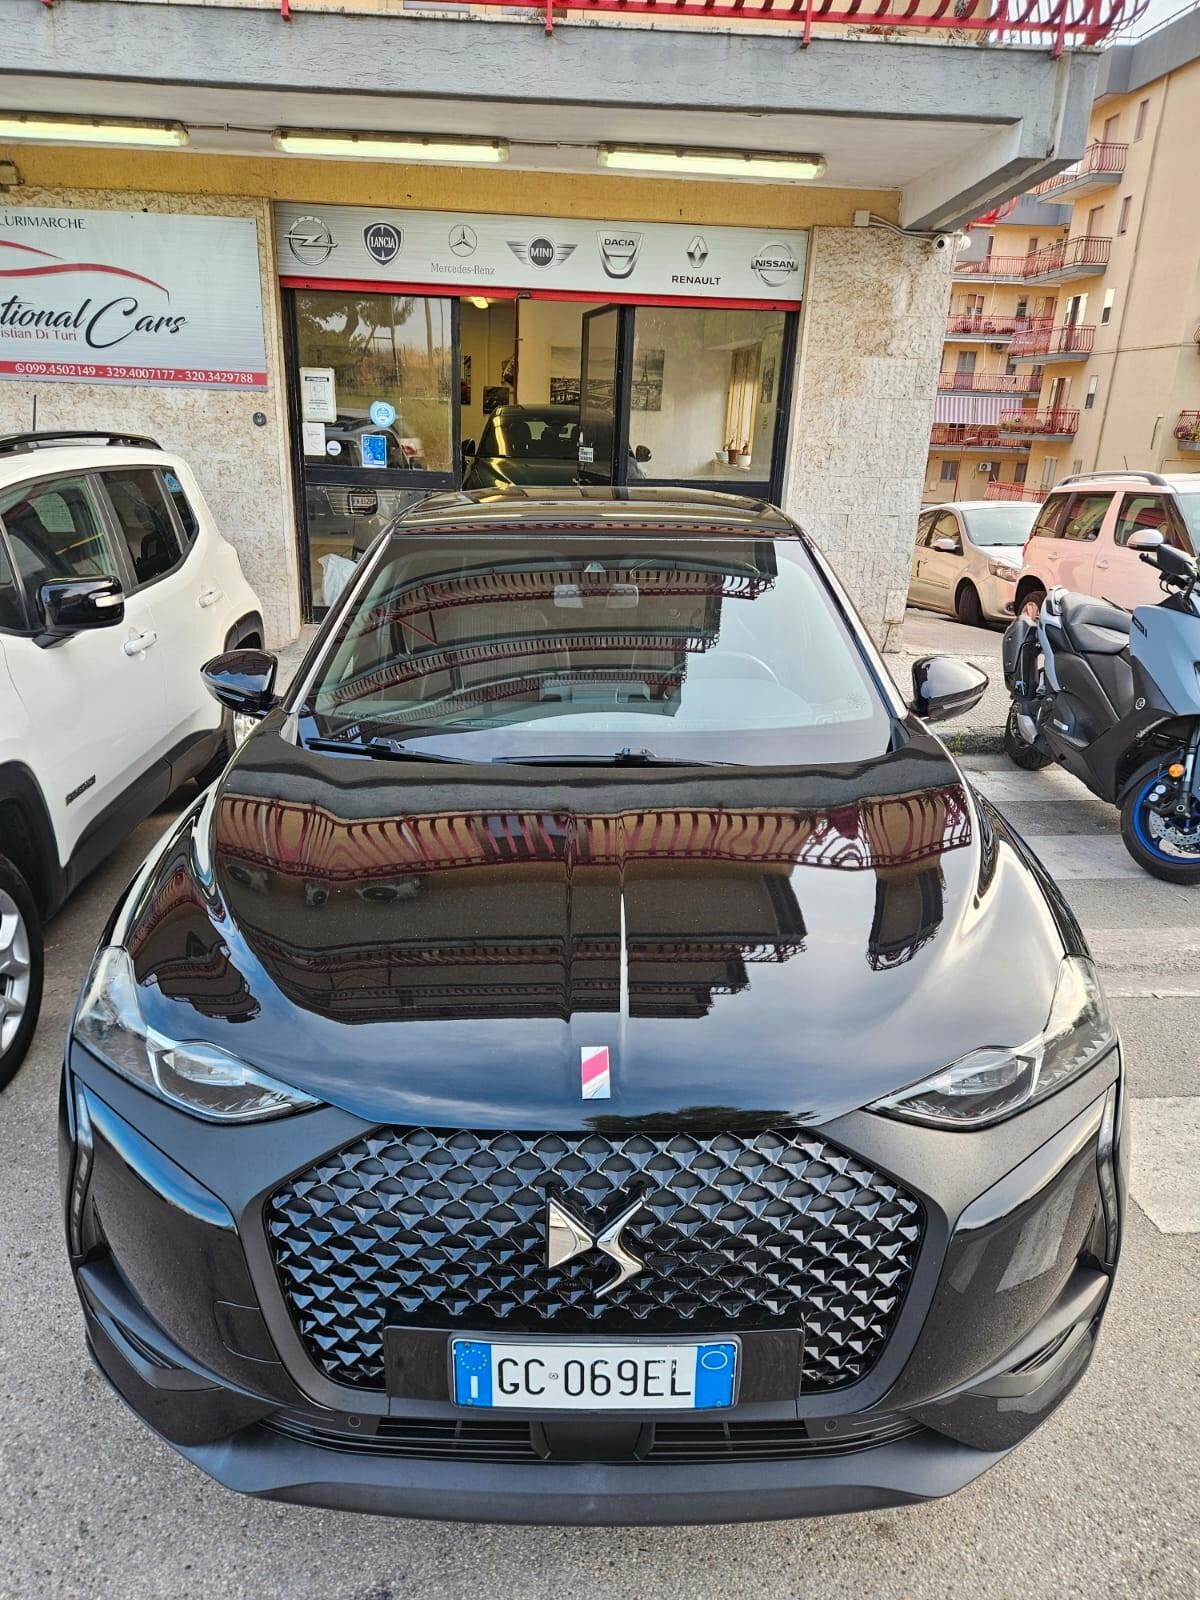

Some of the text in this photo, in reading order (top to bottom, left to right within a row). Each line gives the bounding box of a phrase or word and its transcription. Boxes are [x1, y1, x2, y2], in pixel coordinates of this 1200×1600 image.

[370, 236, 396, 249] LANCIA
[604, 237, 635, 247] DACIA
[530, 247, 553, 258] MINI
[430, 263, 496, 275] Mercedes-Benz
[755, 259, 794, 269] NISSAN
[671, 275, 721, 286] RENAULT
[0, 295, 189, 349] tional Cars
[36, 328, 49, 340] Di
[52, 329, 77, 341] Turi
[25, 363, 96, 377] 099.4502149
[106, 367, 175, 380] 329.4007177
[185, 371, 253, 383] 320.3429788
